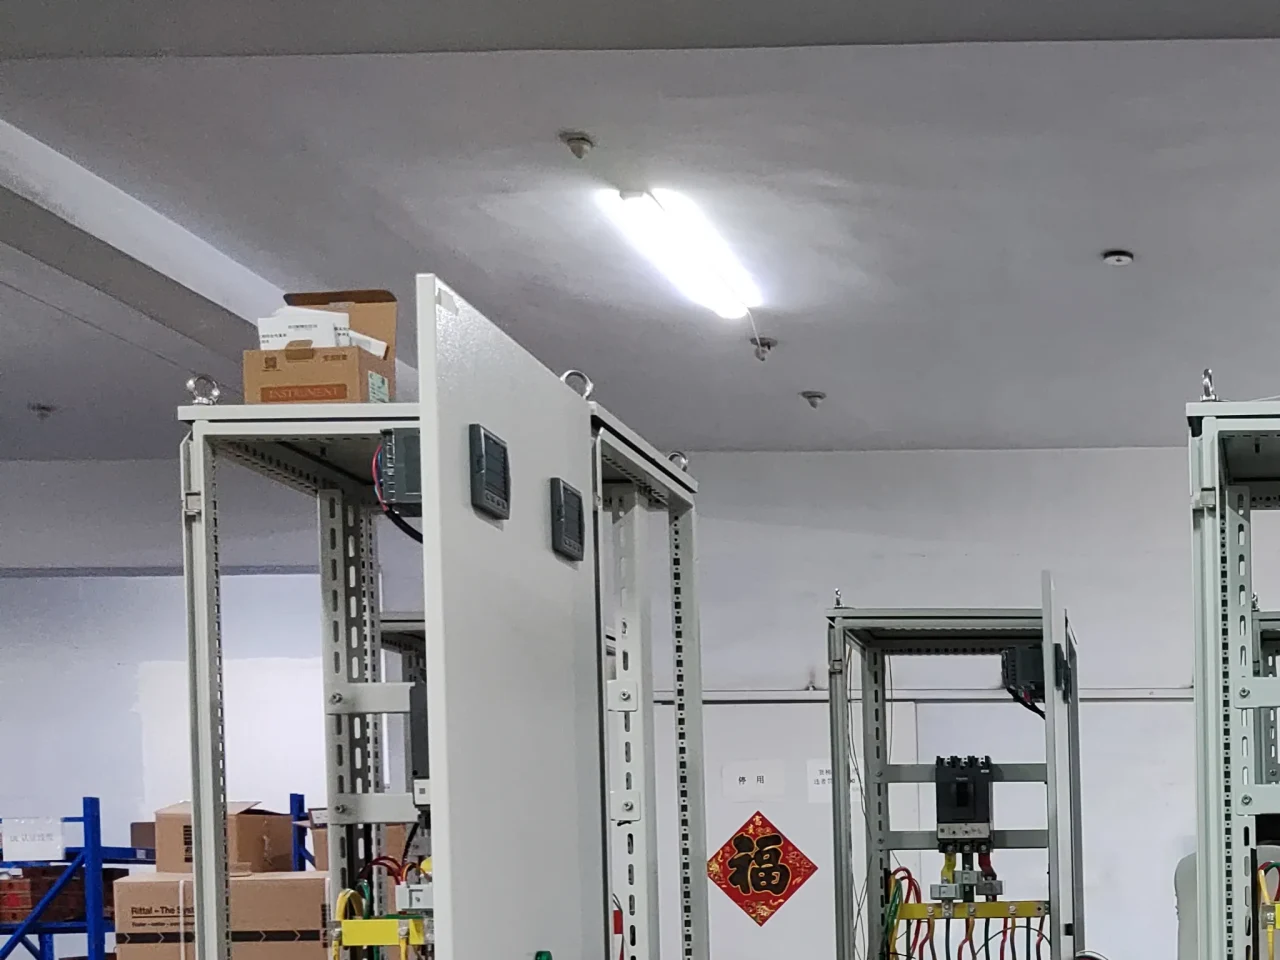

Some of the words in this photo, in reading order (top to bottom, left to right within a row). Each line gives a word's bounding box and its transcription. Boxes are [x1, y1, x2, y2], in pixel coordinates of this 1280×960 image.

[727, 832, 791, 896] 福
[131, 906, 152, 914] Rittal
[160, 906, 175, 914] The
